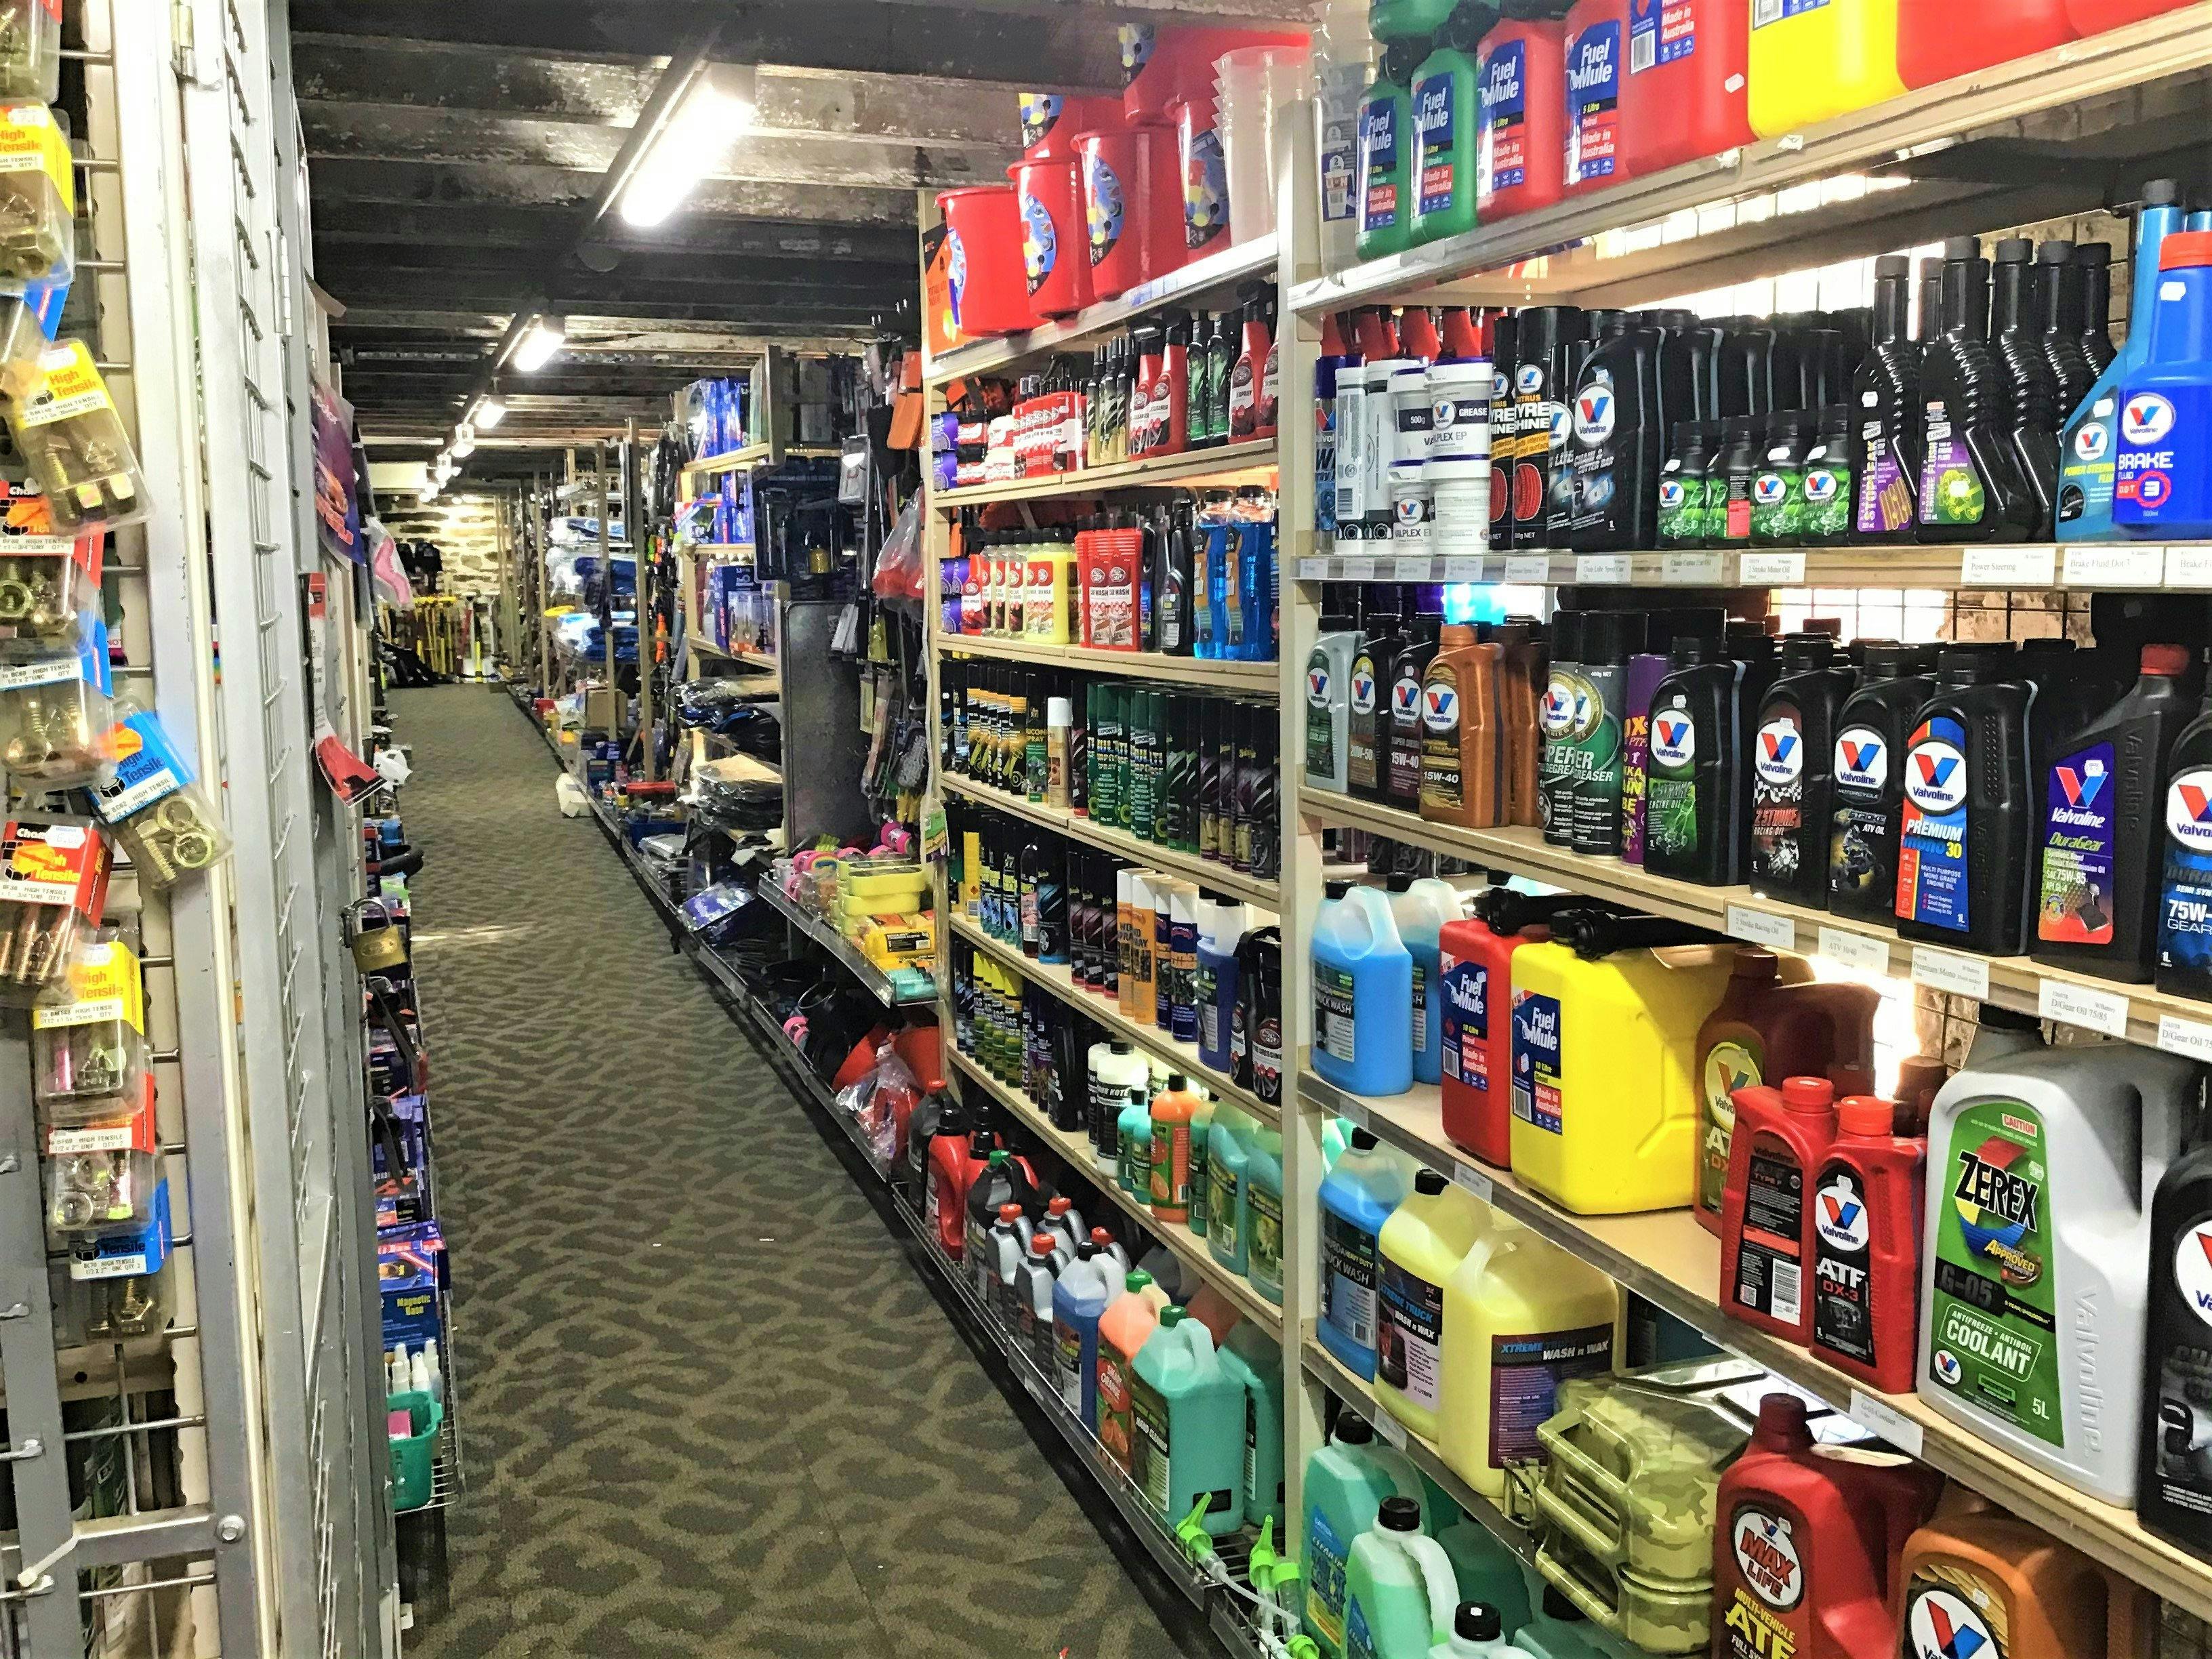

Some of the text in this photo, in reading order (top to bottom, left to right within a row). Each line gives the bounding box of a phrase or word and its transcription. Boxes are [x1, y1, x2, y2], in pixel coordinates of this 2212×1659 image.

[1662, 11, 1683, 26] Made
[1684, 6, 1692, 18] in
[1662, 20, 1694, 41] Australia
[1580, 37, 1612, 68] Fuel
[1490, 56, 1517, 84] Fuel
[1580, 64, 1613, 89] Mule
[1423, 87, 1447, 114] Fuel
[1490, 79, 1519, 105] Mule
[1367, 110, 1391, 137] Fuel
[1422, 109, 1449, 132] Mule
[1368, 132, 1393, 153] Mule
[1581, 129, 1611, 146] Made in
[1511, 141, 1520, 153] in
[1581, 143, 1615, 160] Australia
[1493, 155, 1523, 171] Australia
[1441, 168, 1449, 179] in
[1424, 181, 1452, 196] Australia
[1368, 199, 1396, 212] Australia
[49, 370, 80, 386] High
[1458, 407, 1488, 417] GREASE
[1455, 431, 1468, 441] EP
[1579, 425, 1607, 434] Valvoline
[2118, 451, 2174, 470] BRAKE
[2144, 480, 2160, 497] 3
[1782, 565, 1790, 573] Oil
[1971, 562, 2017, 573] Power Steering
[2070, 559, 2089, 568] Brake
[2111, 558, 2125, 568] Dot
[2180, 560, 2203, 569] Brake
[1427, 714, 1452, 724] Valvoline
[1391, 752, 1419, 769] 15W-40
[1656, 747, 1687, 760] Valvoline
[121, 756, 166, 784] Tensile
[1760, 762, 1793, 775] Valvoline
[1423, 771, 1459, 784] 15W-40
[1839, 771, 1877, 785] Valvoline
[1837, 788, 1879, 800] MOTORCYCLE
[1912, 786, 1954, 802] Valvoline
[2051, 806, 2106, 828] Valvoline
[1862, 823, 1885, 836] ATV OIL
[1906, 819, 1963, 842] PREMIUM
[1903, 834, 1963, 859] mono 30
[2049, 832, 2106, 852] DuraGear
[35, 867, 82, 883] Tensile
[1937, 867, 1961, 878] PURPOSE
[1939, 875, 1957, 884] GRADE
[2046, 869, 2087, 885] SAE 75W-85
[43, 888, 67, 896] TENSILE
[2175, 884, 2194, 895] SEMI
[1754, 922, 1771, 933] Racing
[1770, 926, 1779, 935] Oil
[1912, 961, 1938, 975] Premium
[1938, 967, 1957, 979] Mono
[81, 983, 123, 1000] Tensile
[1461, 973, 1482, 996] Fuel
[1330, 999, 1352, 1015] WASH
[1460, 991, 1484, 1015] Mule
[2051, 998, 2108, 1021] D/Gear Oil 75/85
[1532, 1006, 1555, 1031] Fuel
[1530, 1025, 1557, 1051] Mule
[2162, 1028, 2204, 1046] D/Gear Oil
[1462, 1047, 1485, 1062] Made in
[1462, 1061, 1488, 1075] Australia
[1535, 1086, 1559, 1103] Made in
[1536, 1100, 1561, 1115] Australia
[2003, 1115, 2036, 1135] CAUTION
[79, 1133, 124, 1143] HIGH TENSILE
[1953, 1149, 2040, 1232] ZEREX
[1821, 1223, 1860, 1246] Valvoline
[101, 1258, 136, 1267] HIGH TENSILE
[1984, 1239, 2035, 1272] APPROVED
[1343, 1261, 1370, 1286] WASH
[1816, 1257, 1866, 1289] ATF
[1823, 1280, 1860, 1303] DX-3
[1940, 1264, 1994, 1307] G-05
[396, 1295, 431, 1307] Magnetic
[405, 1306, 424, 1315] Base
[1405, 1298, 1433, 1324] TRUCK
[1394, 1309, 1436, 1340] WASH WAX
[1950, 1309, 1994, 1336] ANTIFREEZE
[1999, 1331, 2032, 1355] ANTIBOIL
[1500, 1341, 1544, 1353] XTREME
[1542, 1340, 1610, 1361] WASH n WAX
[1946, 1319, 2031, 1375] COOLANT
[2032, 1397, 2050, 1420] 5L
[1740, 1525, 1797, 1590] MAX
[1746, 1559, 1783, 1600] LIFE
[1734, 1587, 1796, 1644] MULTI-VEHICLE
[1725, 1601, 1798, 1659] ATF
[1732, 1634, 1748, 1655] FULL
